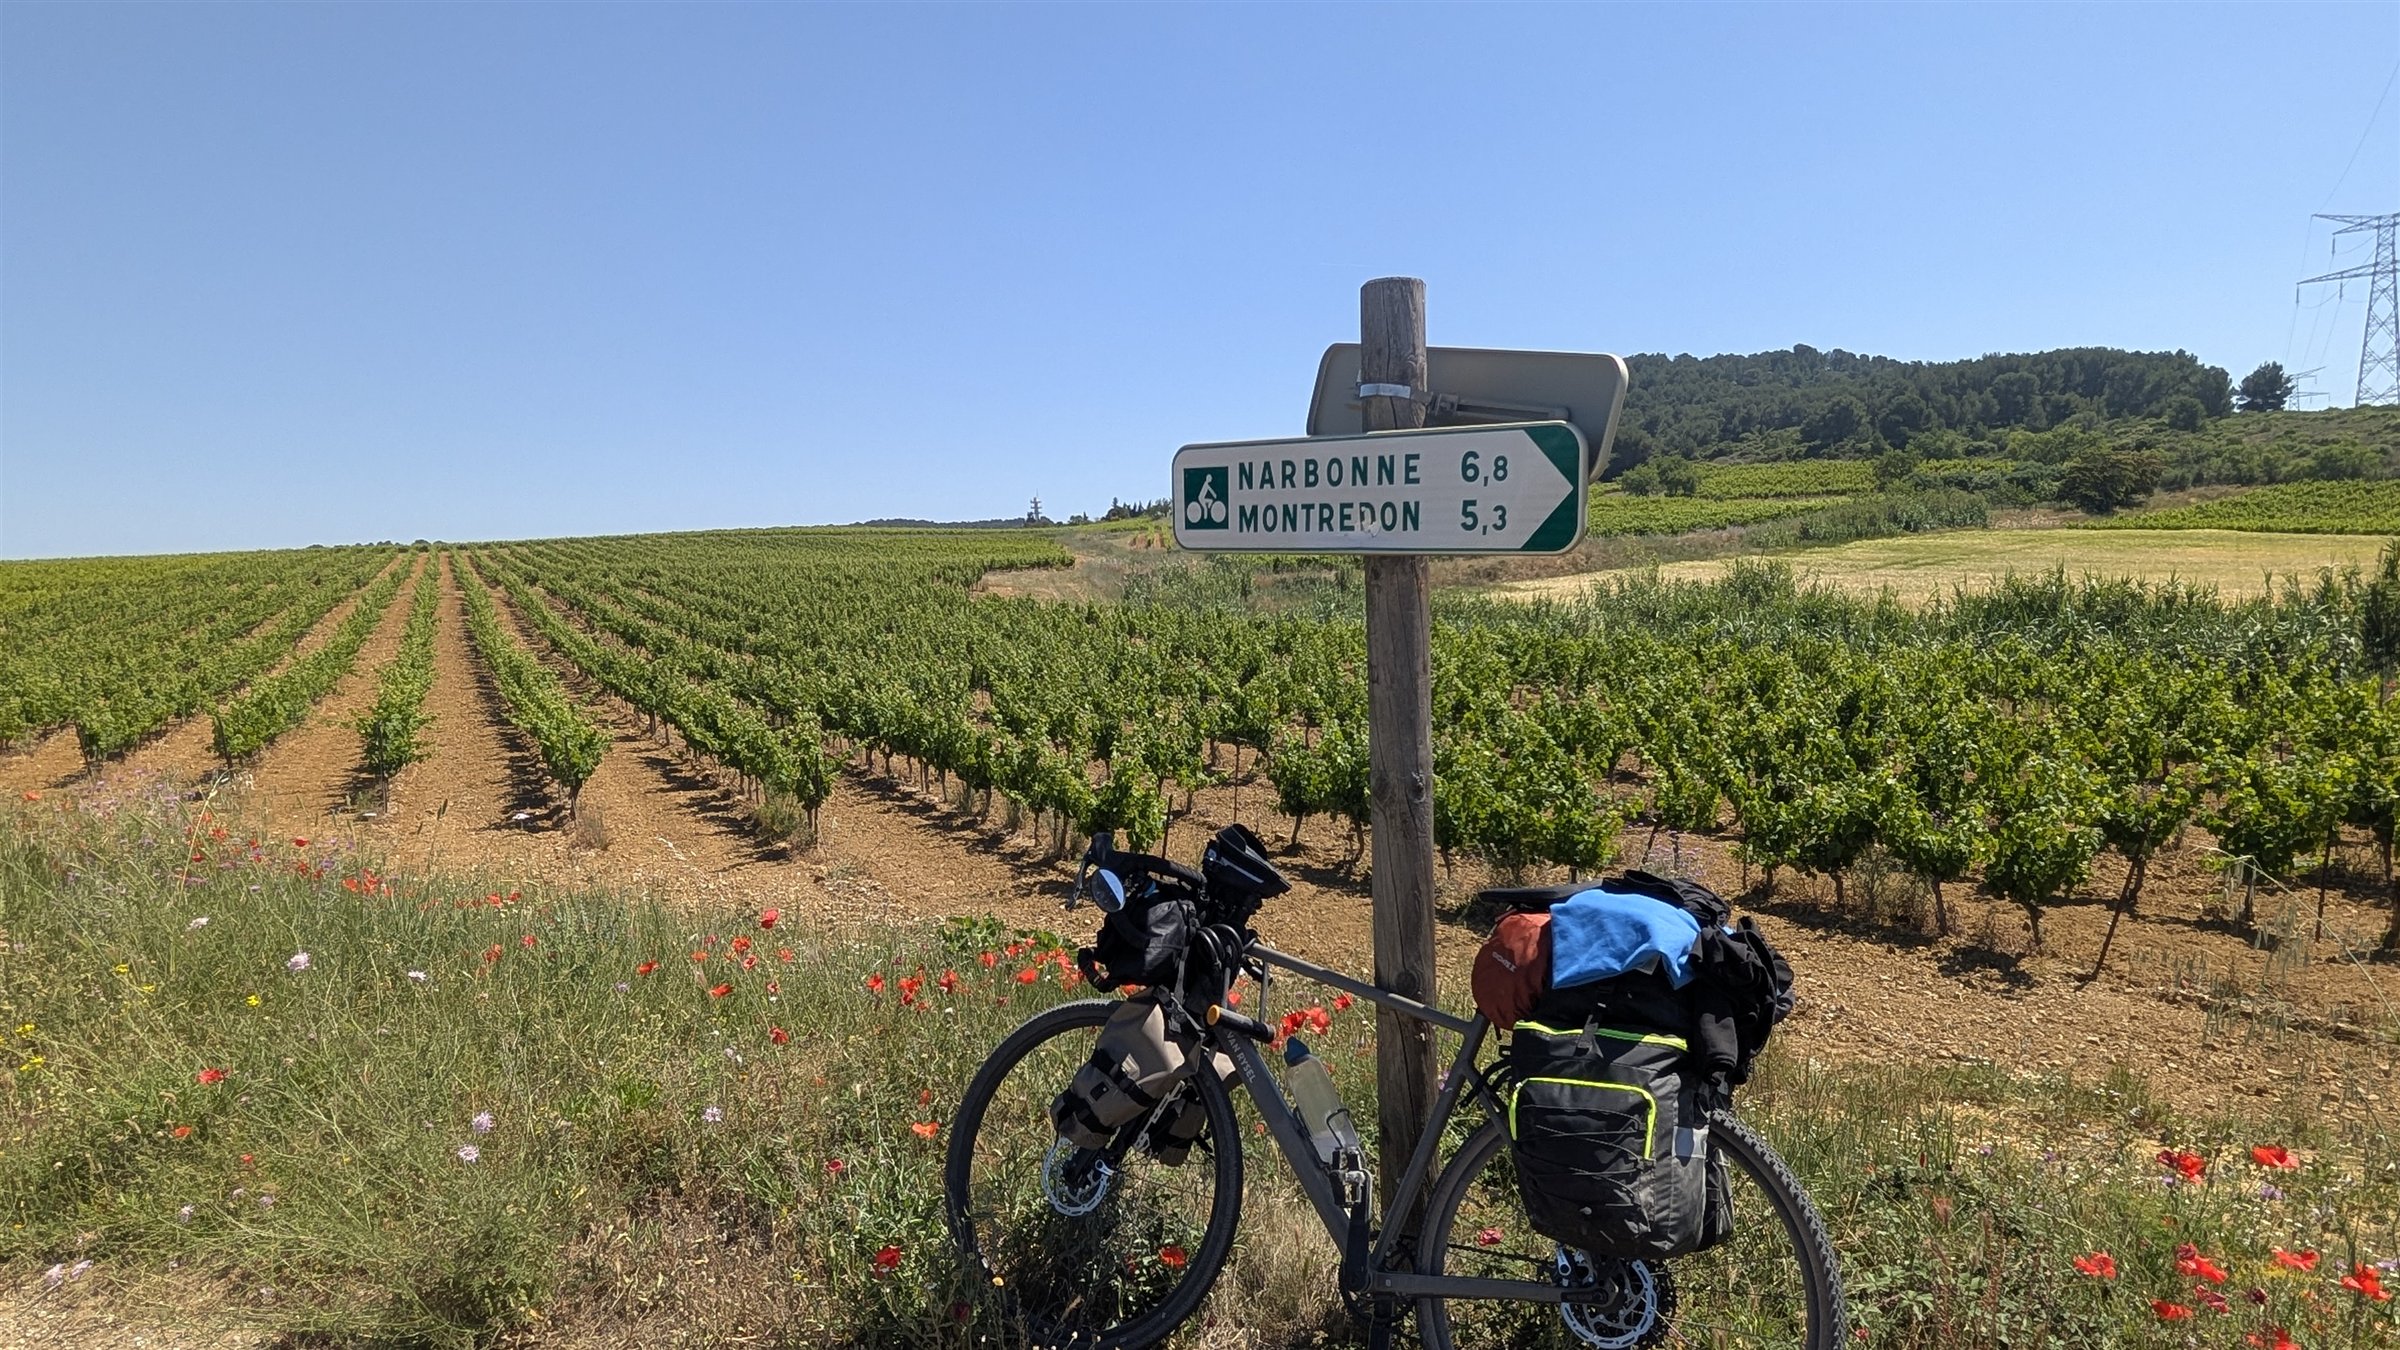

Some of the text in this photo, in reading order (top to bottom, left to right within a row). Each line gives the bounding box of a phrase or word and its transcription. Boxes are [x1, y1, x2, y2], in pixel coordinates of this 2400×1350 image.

[1239, 451, 1508, 490] NARBONNE 6,8
[1239, 499, 1507, 536] MONTREDON 5,3
[1227, 1031, 1256, 1083] VAN RYSEL
